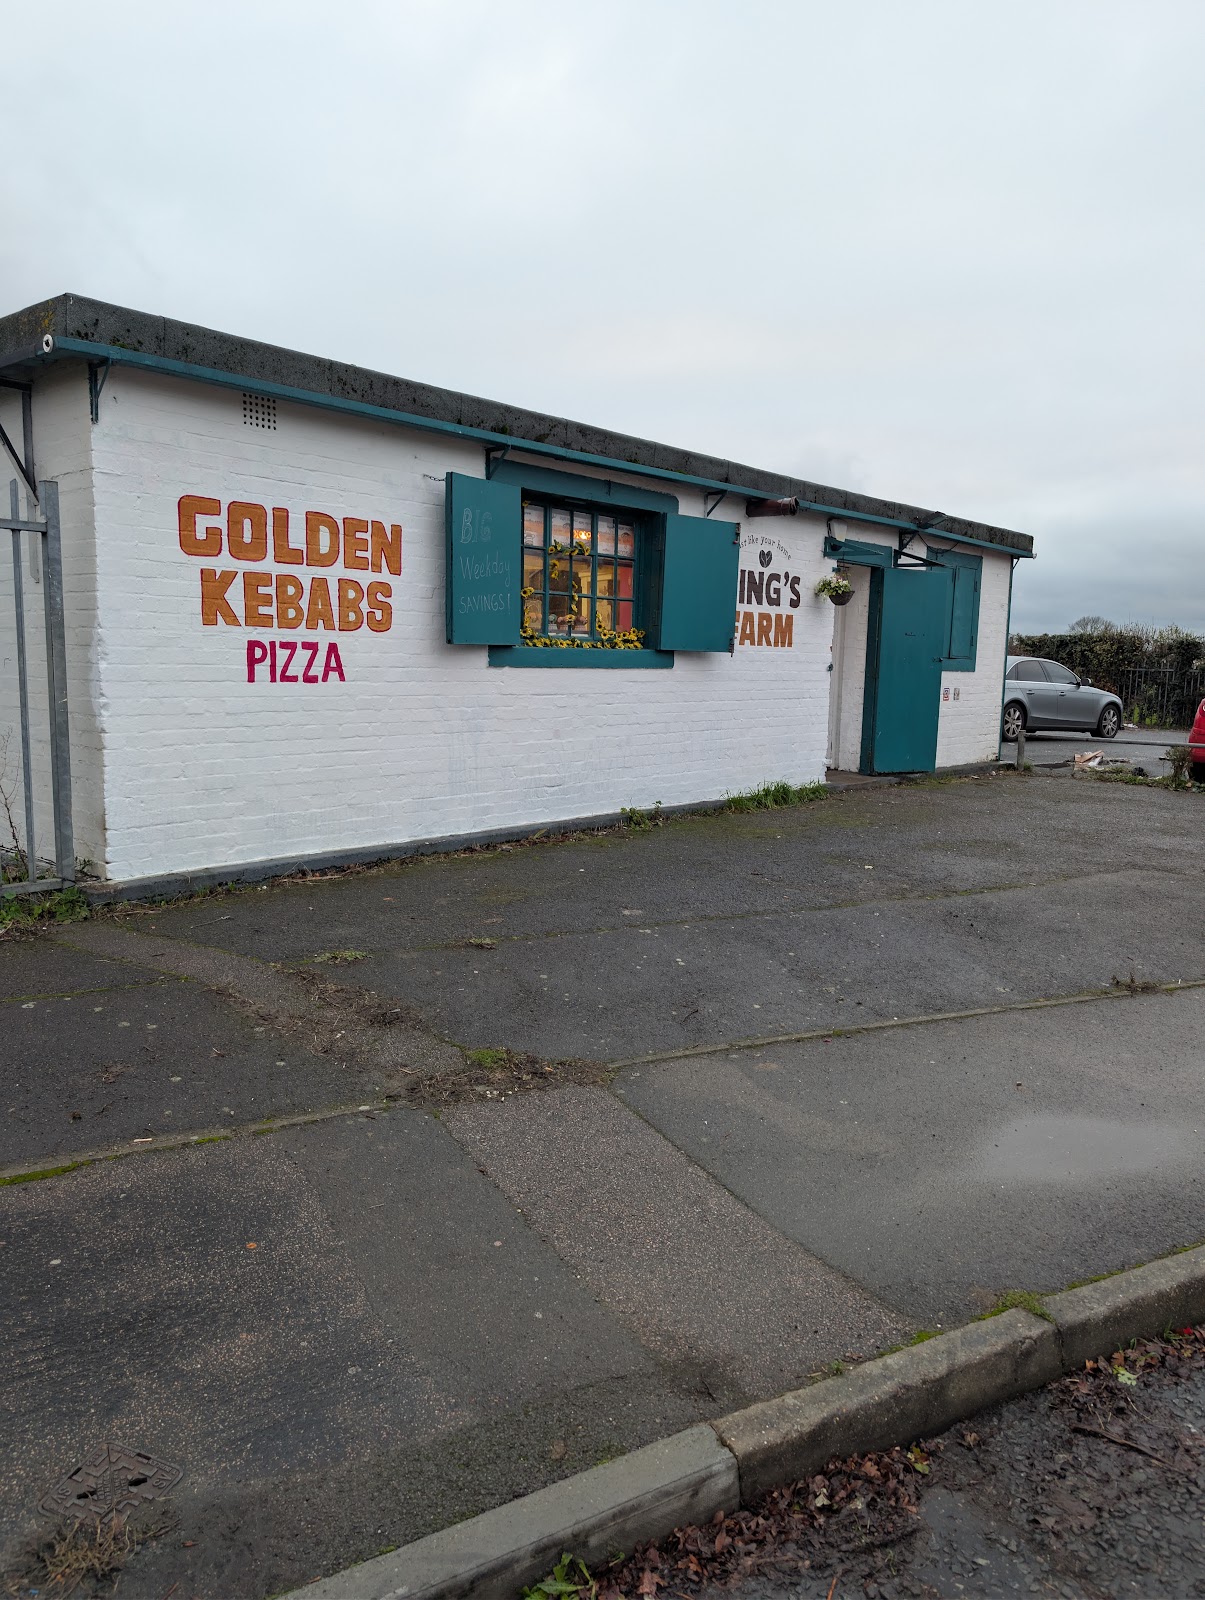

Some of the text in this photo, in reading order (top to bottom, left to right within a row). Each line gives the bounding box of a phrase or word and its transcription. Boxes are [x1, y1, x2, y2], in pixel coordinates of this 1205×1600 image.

[178, 494, 402, 576] GOLDEN
[460, 508, 492, 544] BIG
[748, 535, 759, 544] like
[761, 536, 775, 546] your
[777, 540, 792, 560] home
[460, 551, 510, 587] Weekday
[201, 568, 393, 632] KEBABS
[459, 593, 511, 615] SAVINGS!
[739, 569, 801, 608] ING'S
[246, 640, 346, 683] PIZZA
